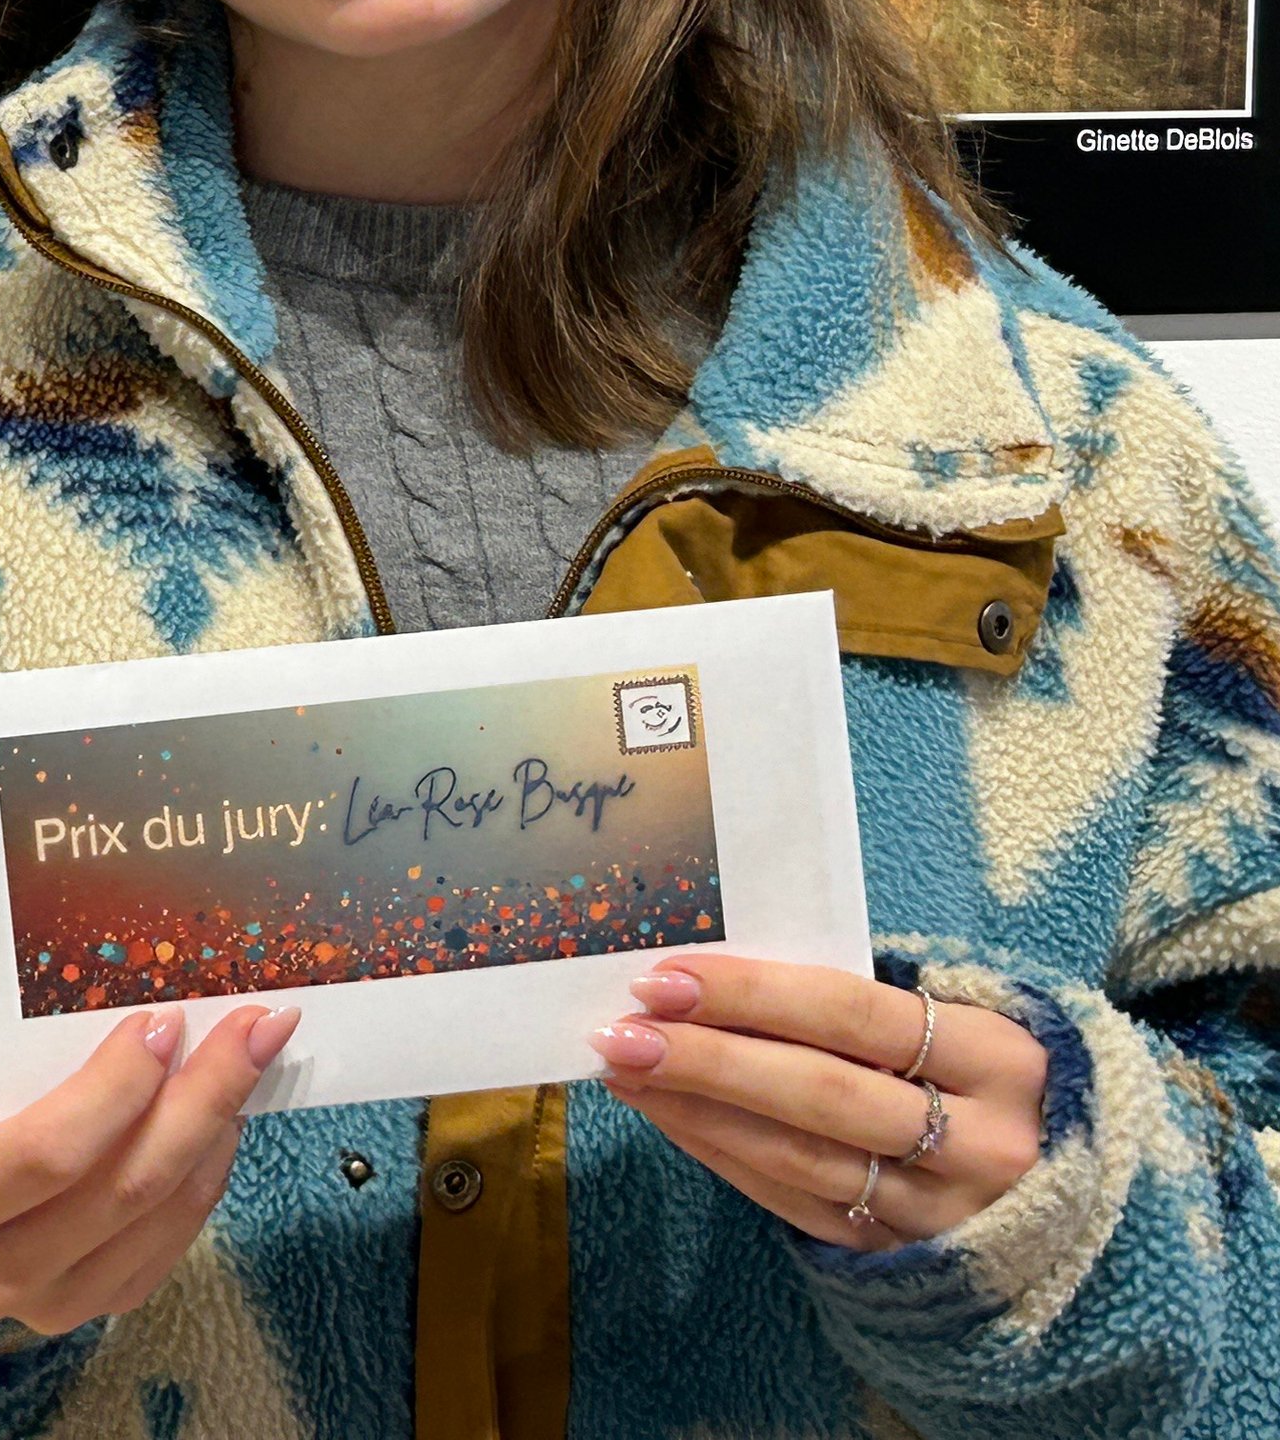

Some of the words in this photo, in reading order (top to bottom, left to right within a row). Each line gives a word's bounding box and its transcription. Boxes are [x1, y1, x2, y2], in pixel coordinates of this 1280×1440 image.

[1076, 128, 1160, 152] Ginette
[1166, 126, 1254, 151] DeBlois
[34, 813, 128, 862] Prix
[142, 805, 206, 851] du
[222, 799, 327, 854] jury:
[513, 758, 636, 832] Busque
